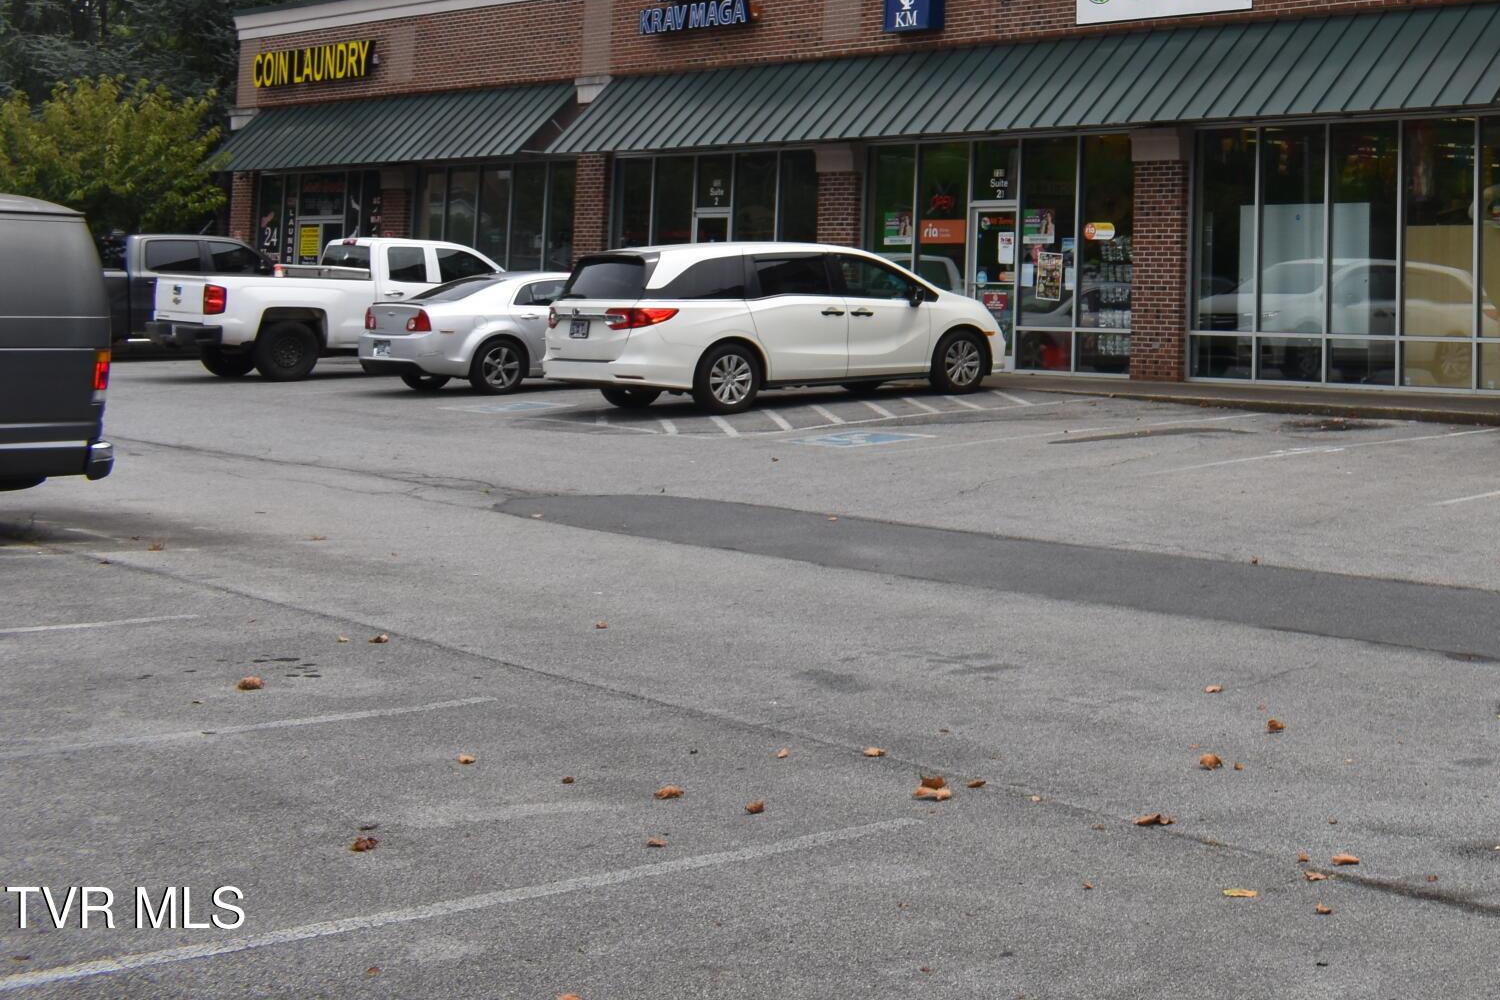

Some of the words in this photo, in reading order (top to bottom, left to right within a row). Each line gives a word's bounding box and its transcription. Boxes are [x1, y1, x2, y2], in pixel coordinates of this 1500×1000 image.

[639, 3, 688, 34] KRAV
[895, 10, 918, 28] KM
[253, 51, 289, 88] COIN
[293, 40, 370, 83] LAUNDRY
[264, 227, 278, 246] 24
[286, 209, 295, 263] LAUNDR
[923, 223, 939, 238] ria
